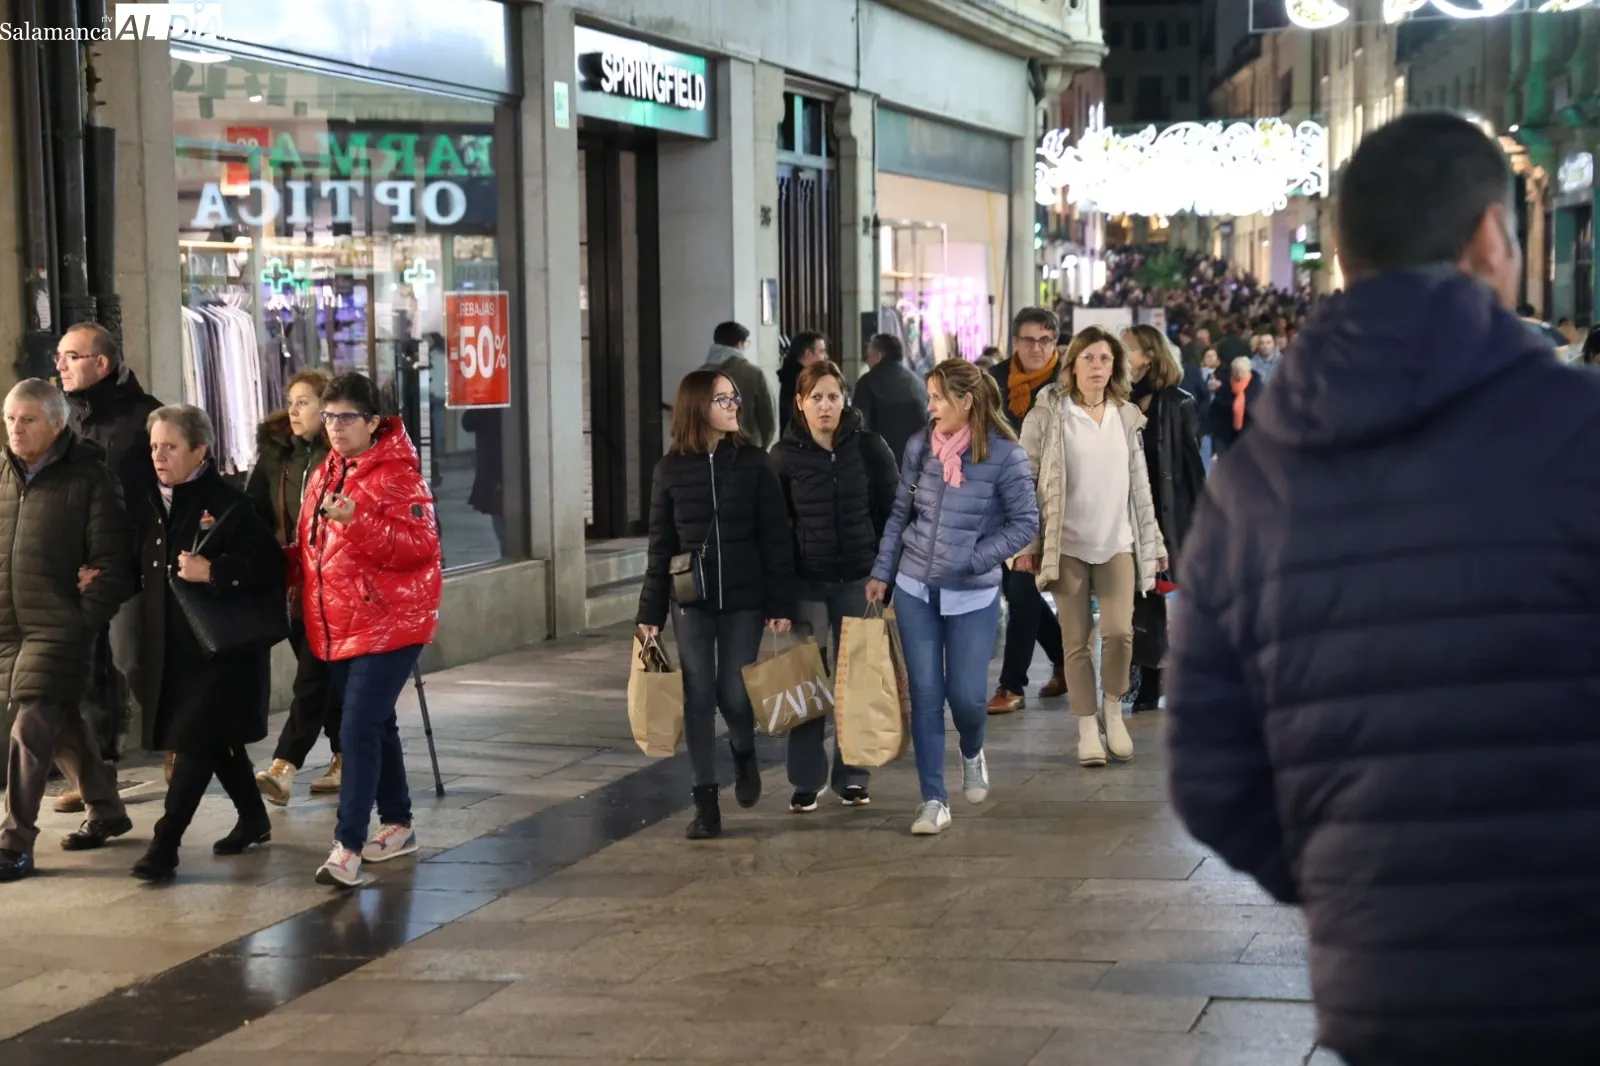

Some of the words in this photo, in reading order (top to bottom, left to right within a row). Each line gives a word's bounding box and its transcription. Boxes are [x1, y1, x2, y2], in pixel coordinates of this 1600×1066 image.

[601, 51, 706, 111] SPRINGFIELD
[460, 302, 495, 316] REBAJAS
[762, 675, 835, 734] ZARA
